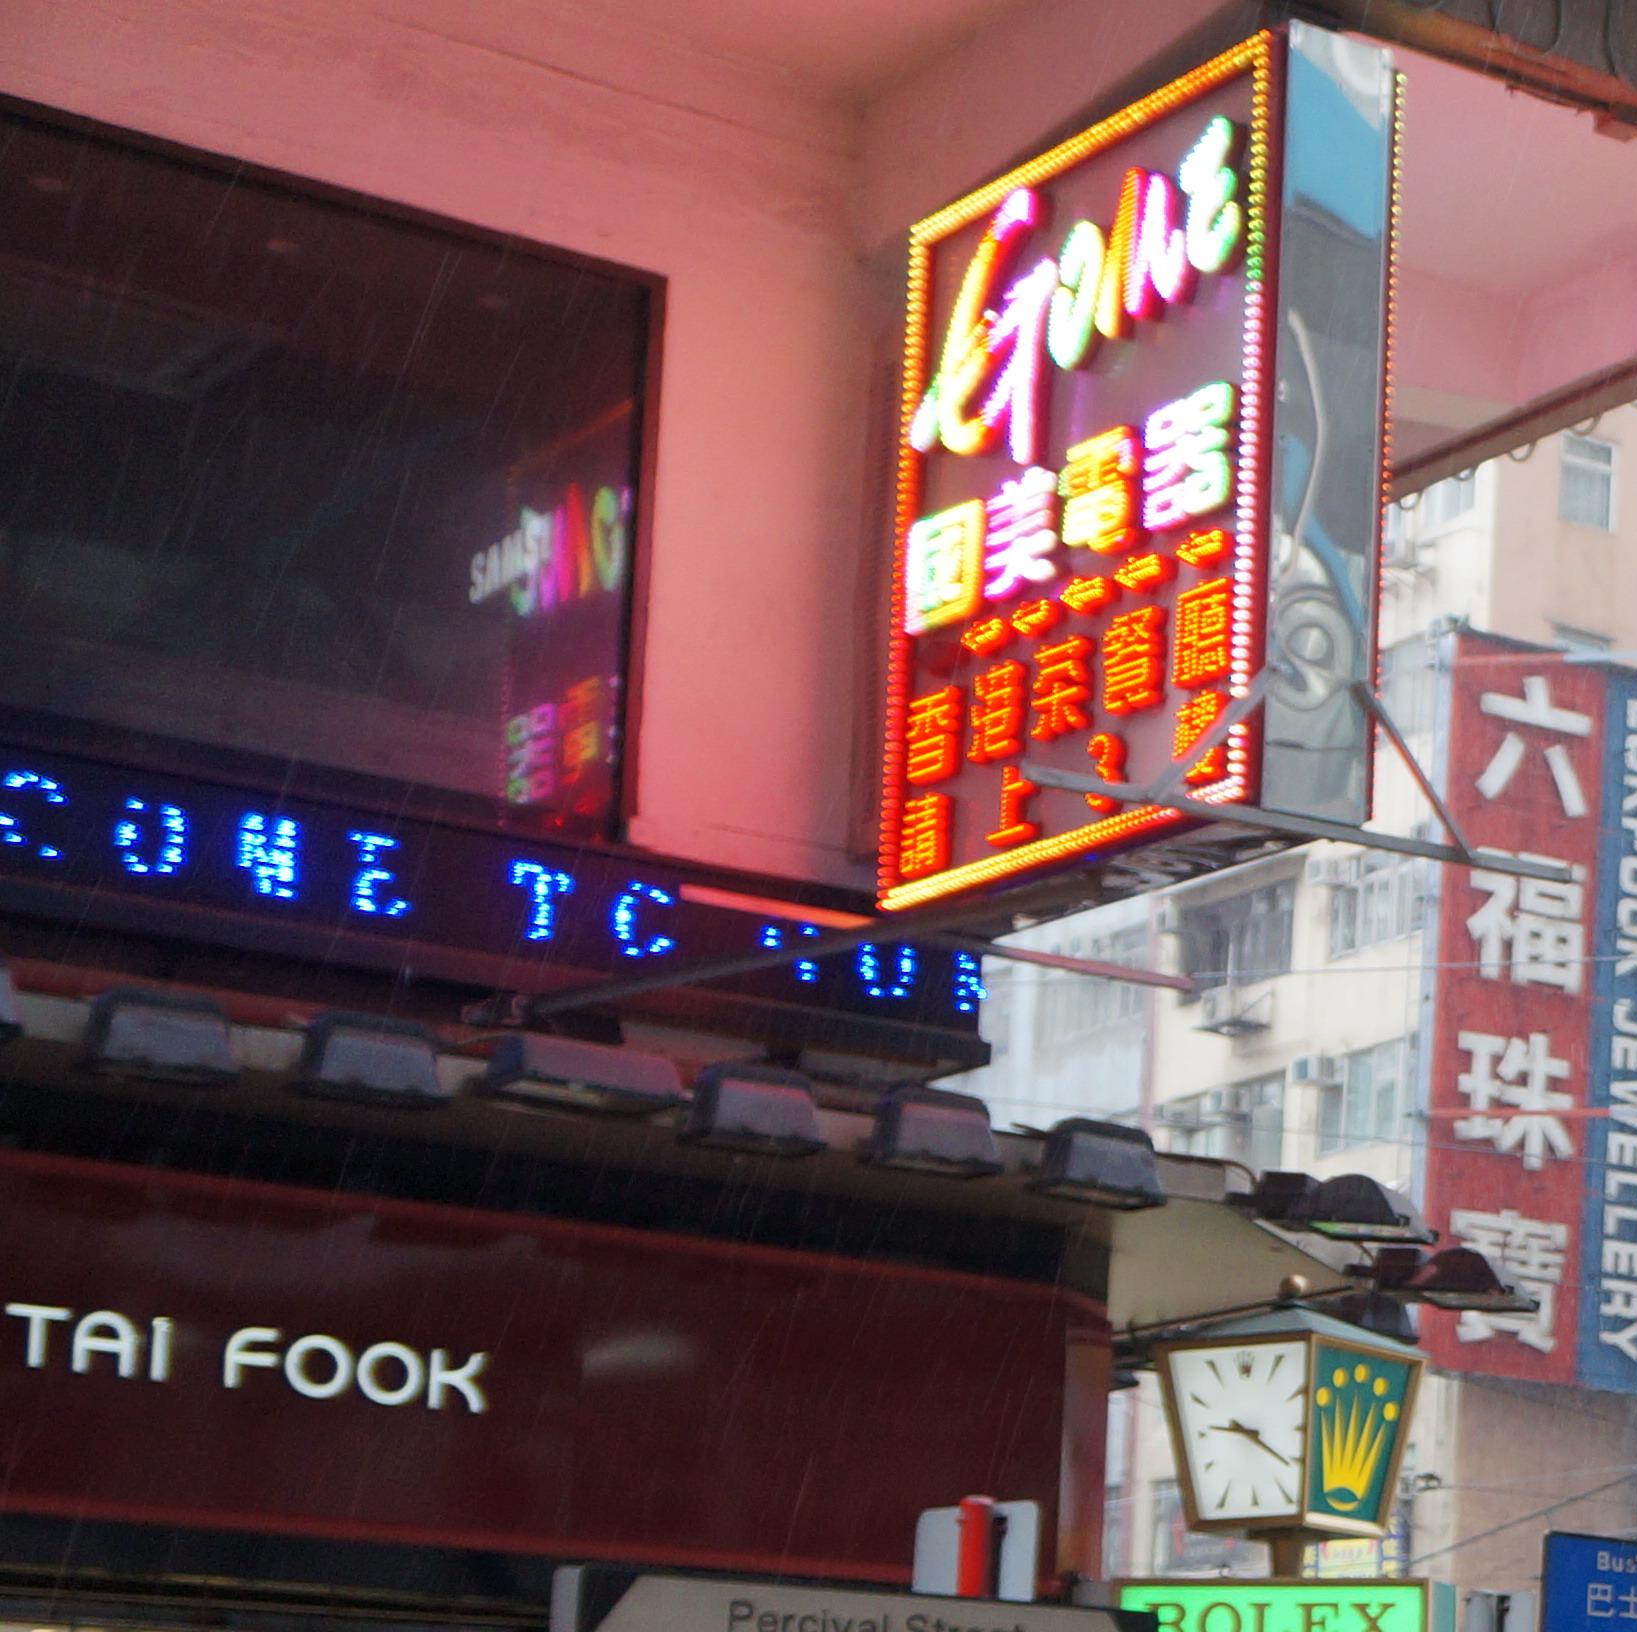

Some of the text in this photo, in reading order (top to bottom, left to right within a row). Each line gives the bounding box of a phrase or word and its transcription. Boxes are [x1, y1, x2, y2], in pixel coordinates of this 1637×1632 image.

[1450, 675, 1593, 1355] 六福珠寶
[5, 1301, 490, 1415] TAI FOOK
